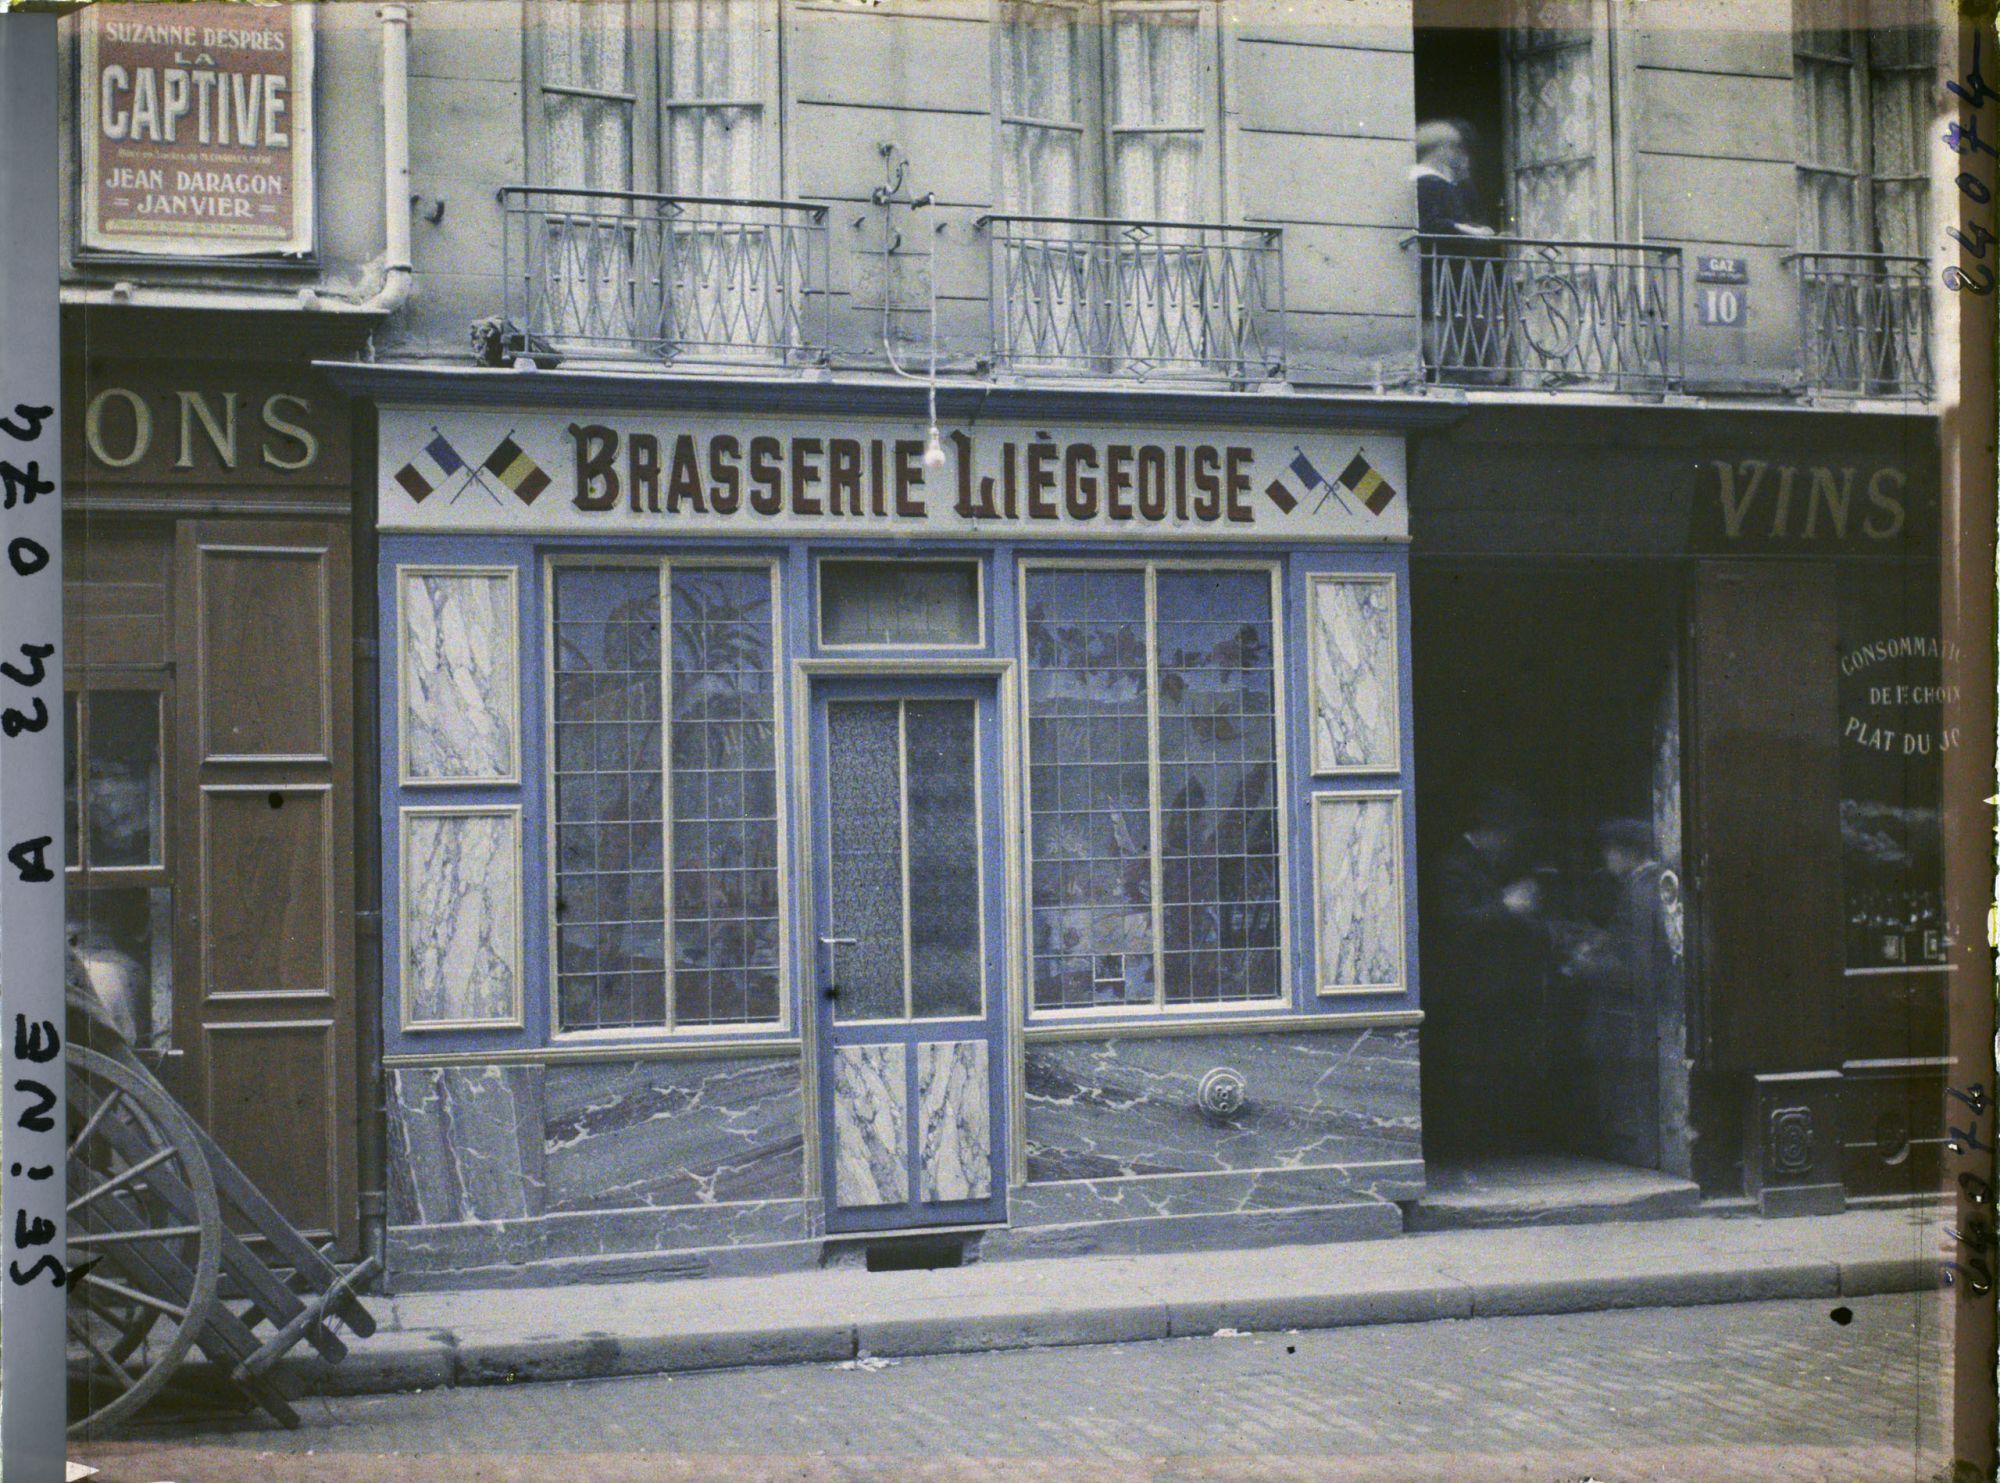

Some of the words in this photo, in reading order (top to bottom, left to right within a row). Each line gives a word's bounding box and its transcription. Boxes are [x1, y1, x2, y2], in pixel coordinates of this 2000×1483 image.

[105, 21, 196, 46] SUZANNE
[203, 27, 286, 50] DESPRÈS
[174, 51, 216, 66] LA
[102, 64, 290, 148] CAPTIVE
[106, 168, 163, 190] JEAN
[177, 171, 283, 195] DARAGON
[137, 195, 254, 218] JANVIER
[1710, 258, 1735, 273] GAZ
[1708, 290, 1737, 323] 10
[568, 422, 929, 518] BRASSERIE
[1710, 458, 1908, 540] VINS
[1870, 686, 1892, 705] DE
[1912, 685, 1960, 705] CHOIX
[1844, 716, 1896, 752] PLAT
[1903, 732, 1931, 755] DU
[8, 835, 55, 883] A
